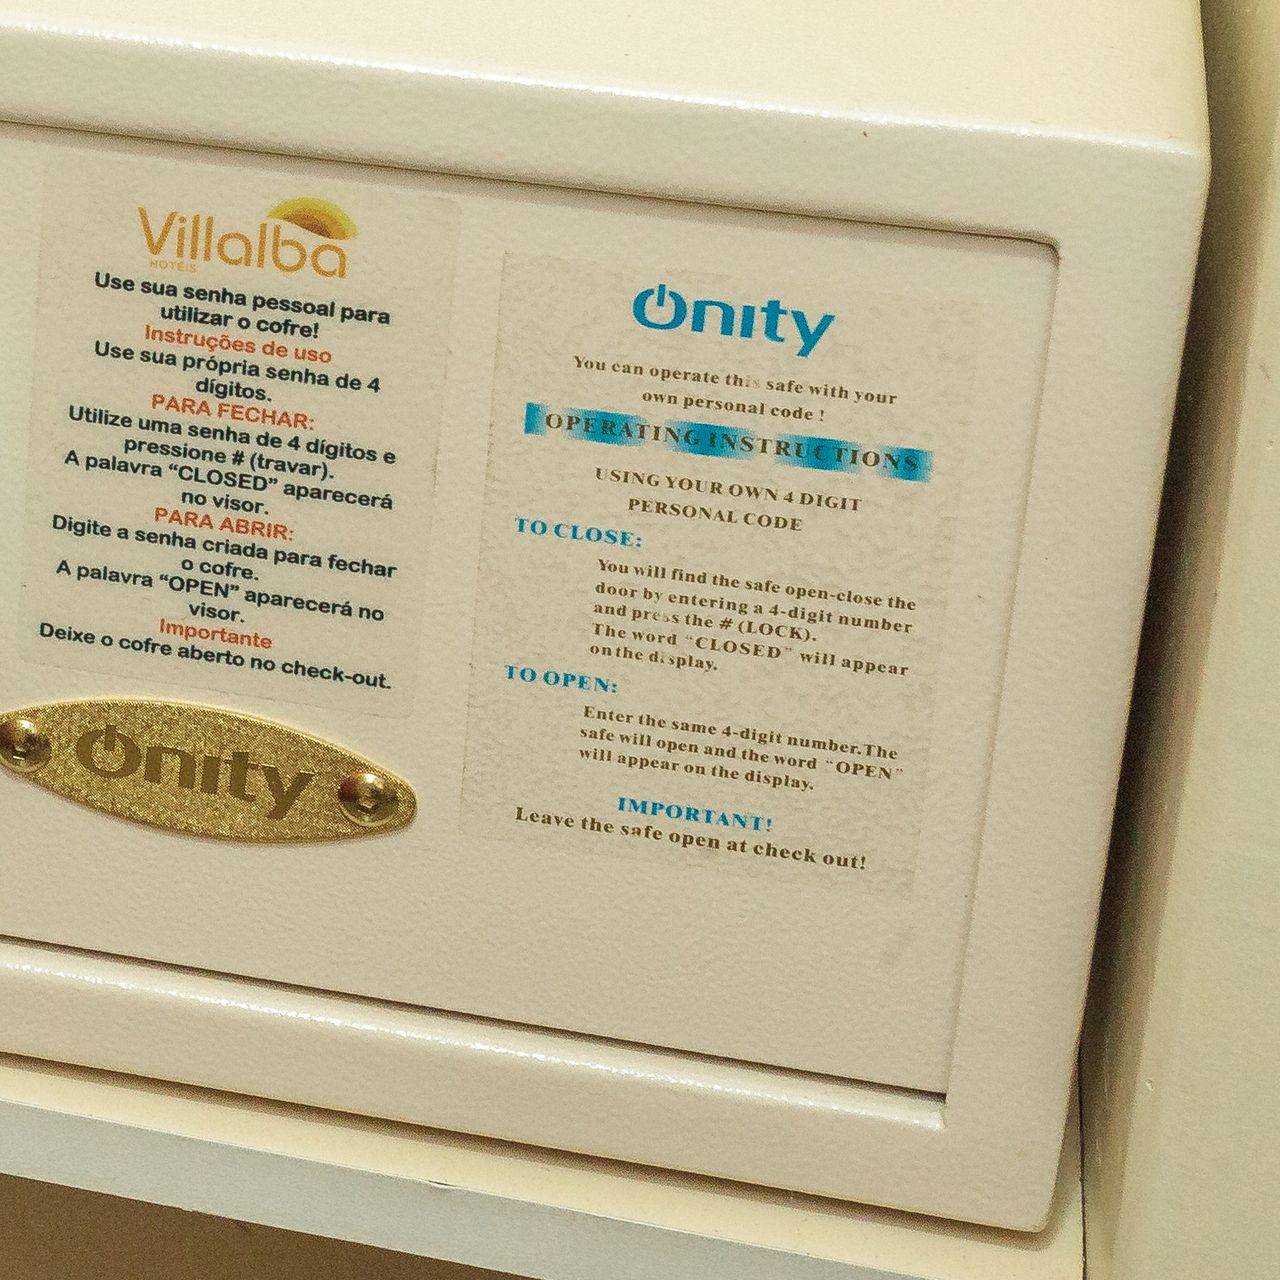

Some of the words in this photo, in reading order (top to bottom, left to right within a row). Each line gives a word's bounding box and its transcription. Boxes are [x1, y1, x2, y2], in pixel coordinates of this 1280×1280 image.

[138, 207, 348, 279] Villalba
[95, 272, 135, 291] Use
[141, 278, 178, 298] sua
[184, 284, 247, 307] senha
[252, 293, 335, 317] pessoal
[341, 304, 391, 325] para
[632, 284, 836, 357] Onity
[145, 324, 256, 353] Instruções
[262, 340, 288, 358] de
[294, 346, 332, 364] uso
[161, 305, 233, 329] utilizar
[238, 315, 250, 330] o
[256, 317, 320, 339] cofre!
[95, 340, 135, 360] Use
[140, 348, 177, 367] sua
[183, 353, 260, 377] própria
[266, 365, 330, 388] senha
[335, 373, 362, 391] de
[366, 377, 380, 393] 4
[574, 355, 606, 373] You
[611, 362, 643, 376] can
[649, 366, 719, 386] operate
[766, 377, 804, 395] safe
[809, 383, 848, 401] with
[855, 389, 898, 407] your
[152, 393, 211, 416] PARA
[217, 401, 315, 430] FECHAR:
[195, 377, 272, 402] dígitos.
[642, 391, 678, 405] own
[683, 395, 766, 416] personal
[770, 405, 814, 421] code
[69, 405, 132, 429] Utilize
[139, 417, 182, 437] uma
[188, 422, 250, 446] senha
[256, 430, 282, 449] de
[287, 435, 301, 451] 4
[306, 436, 377, 462] dígitos
[383, 451, 396, 465] e
[544, 412, 700, 447] OPERATING
[709, 432, 919, 472] INSTRUCTIONS
[64, 449, 79, 466] A
[85, 454, 162, 479] palavra
[283, 481, 393, 510] aparecerá
[124, 436, 227, 464] pressione
[232, 451, 245, 466] #
[249, 452, 334, 481] (travar).
[181, 491, 207, 506] no
[213, 493, 270, 515] visor.
[595, 468, 660, 488] USING
[665, 476, 722, 496] YOUR
[728, 483, 780, 502] OWN
[784, 491, 794, 504] 4
[800, 492, 862, 512] DIGIT
[154, 507, 213, 530] PARA
[219, 516, 294, 541] ABRIR:
[515, 516, 549, 535] TO
[554, 523, 642, 548] CLOSE:
[628, 498, 739, 524] PERSONAL
[744, 512, 803, 532] CODE
[52, 515, 112, 538] Digite
[117, 526, 129, 541] a
[135, 526, 196, 551] senha
[202, 536, 268, 560] criada
[273, 549, 322, 569] para
[327, 552, 398, 579] fechar
[56, 560, 71, 576] A
[77, 563, 154, 588] palavra
[244, 589, 353, 617] aparecerá
[358, 605, 385, 621] no
[181, 558, 194, 572] o
[199, 558, 259, 581] cofre.
[598, 559, 629, 575] You
[633, 562, 667, 580] will
[671, 567, 707, 585] find
[712, 573, 739, 589] the
[745, 578, 781, 596] safe
[785, 584, 882, 608] open-close
[887, 594, 916, 612] the
[189, 602, 245, 623] visor.
[593, 602, 626, 618] and
[685, 612, 714, 629] the
[719, 617, 733, 630] #
[738, 619, 817, 644] (LOCK).
[595, 581, 638, 598] door
[643, 588, 664, 604] by
[669, 592, 748, 615] entering
[753, 602, 764, 614] a
[769, 603, 832, 624] 4-digit
[839, 613, 913, 634] number
[40, 622, 95, 645] Deixe
[101, 634, 113, 647] o
[119, 634, 172, 656] cofre
[178, 644, 245, 667] aberto
[250, 655, 276, 671] no
[281, 660, 392, 690] check-out.
[159, 619, 273, 649] Importante
[592, 622, 627, 641] The
[632, 629, 678, 646] word
[800, 649, 836, 667] will
[841, 656, 909, 678] appear
[610, 645, 643, 661] the
[505, 664, 538, 683] TO
[543, 671, 618, 694] OPEN:
[584, 705, 634, 725] Enter
[638, 713, 666, 729] the
[671, 720, 717, 736] same
[722, 725, 783, 745] 4-digit
[579, 748, 612, 763] will
[617, 752, 679, 774] appear
[684, 760, 706, 776] on
[710, 764, 739, 781] the
[744, 769, 815, 791] display.
[580, 726, 616, 743] safe
[619, 731, 652, 747] will
[657, 738, 699, 755] open
[704, 743, 737, 760] and
[741, 749, 769, 765] the
[774, 754, 817, 770] word
[76, 724, 316, 820] Onity
[618, 796, 773, 832] IMPORTANT!
[516, 806, 575, 828] Leave
[581, 814, 613, 833] the
[620, 821, 663, 841] safe
[669, 828, 720, 851] open
[726, 837, 747, 853] at
[753, 842, 816, 864] check
[823, 852, 867, 870] out!
